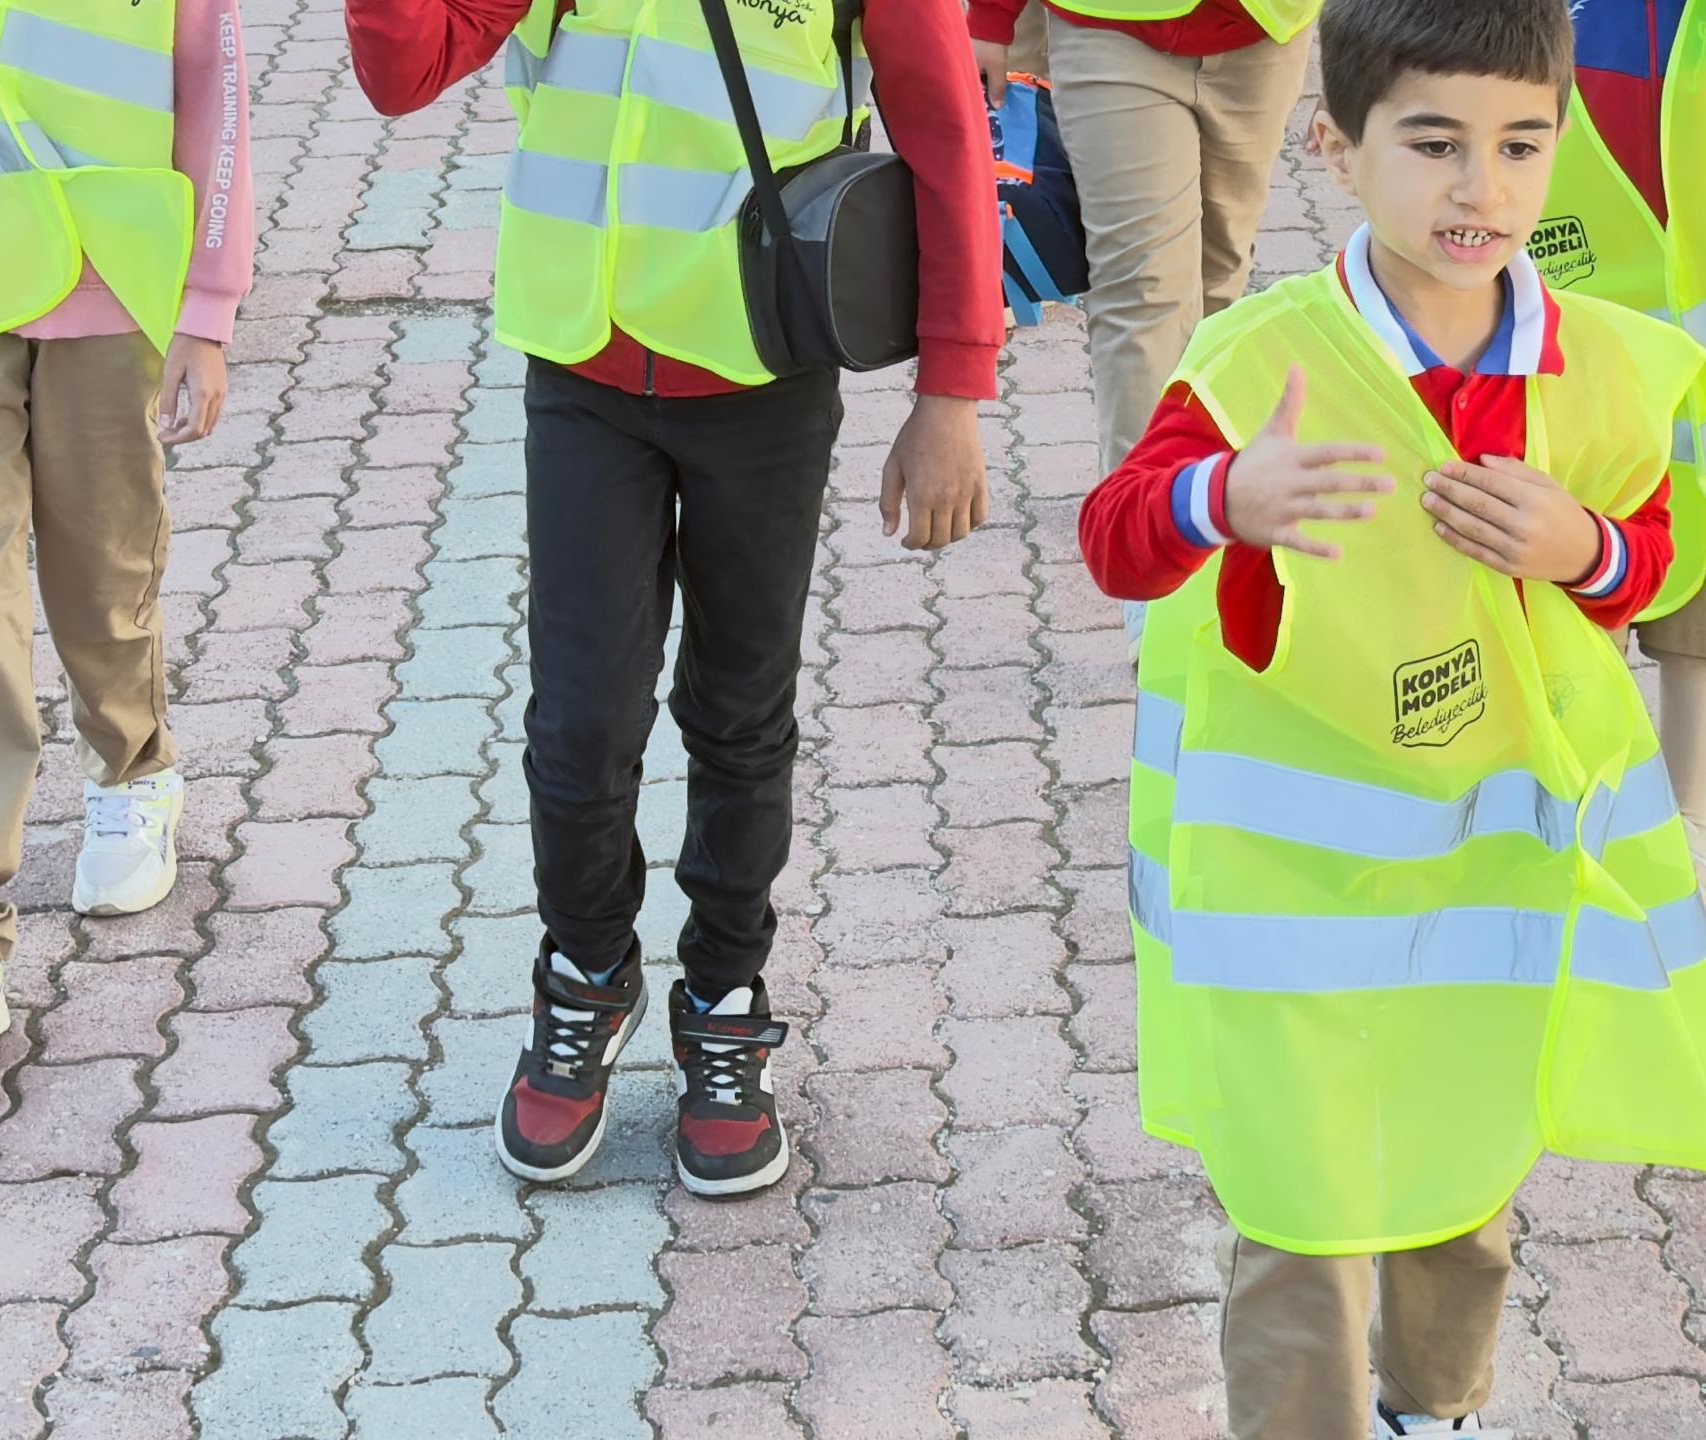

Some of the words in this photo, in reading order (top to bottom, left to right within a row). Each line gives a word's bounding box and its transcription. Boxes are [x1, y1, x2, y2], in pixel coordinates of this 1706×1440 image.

[218, 11, 237, 59] KEEP
[221, 61, 240, 142] TRAINING
[216, 143, 236, 190] KEEP
[206, 192, 230, 249] GOING
[1403, 647, 1476, 696] KONYA
[1391, 685, 1487, 743] Belediyecilik
